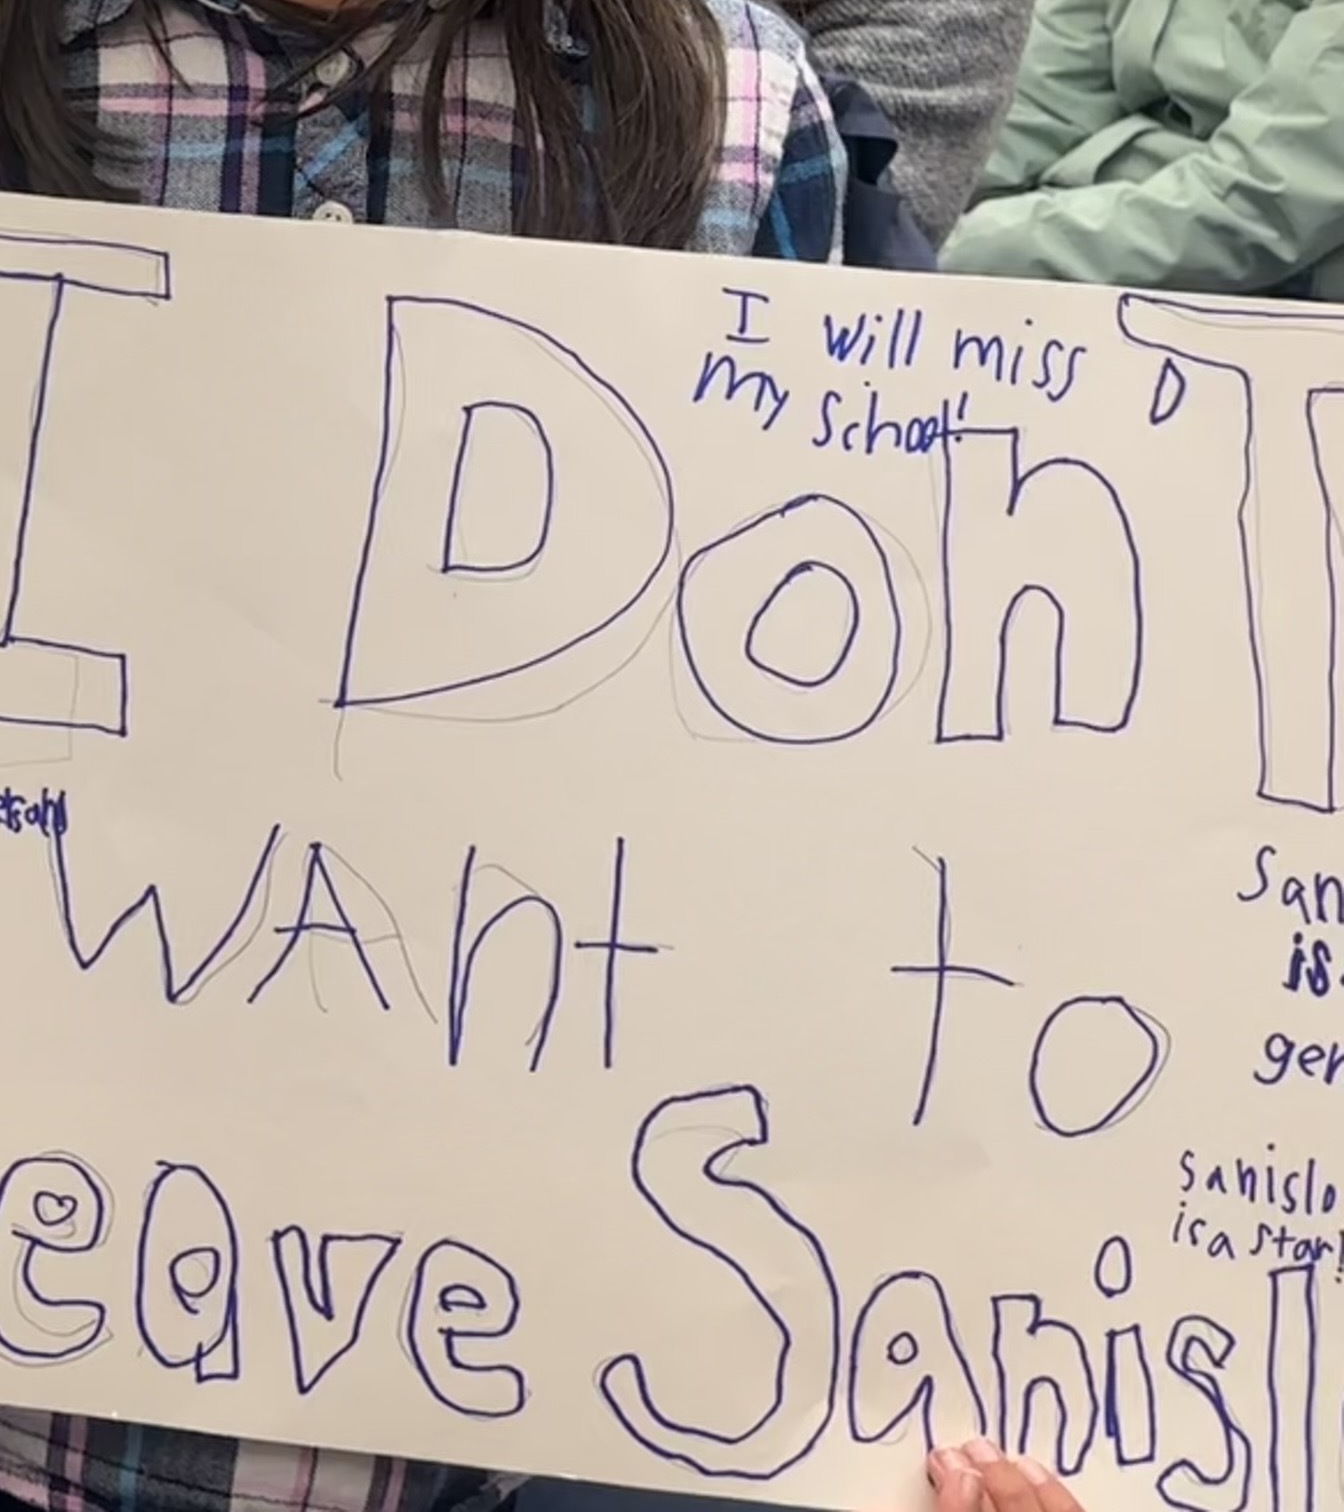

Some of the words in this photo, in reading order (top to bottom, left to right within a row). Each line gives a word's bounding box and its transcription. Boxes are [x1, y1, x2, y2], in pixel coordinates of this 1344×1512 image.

[721, 286, 770, 343] I
[953, 317, 1087, 402] miss
[1236, 844, 1344, 925] San
[889, 856, 1161, 1138] to
[598, 1084, 1344, 1512] Sanisl
[1207, 1230, 1236, 1261] a
